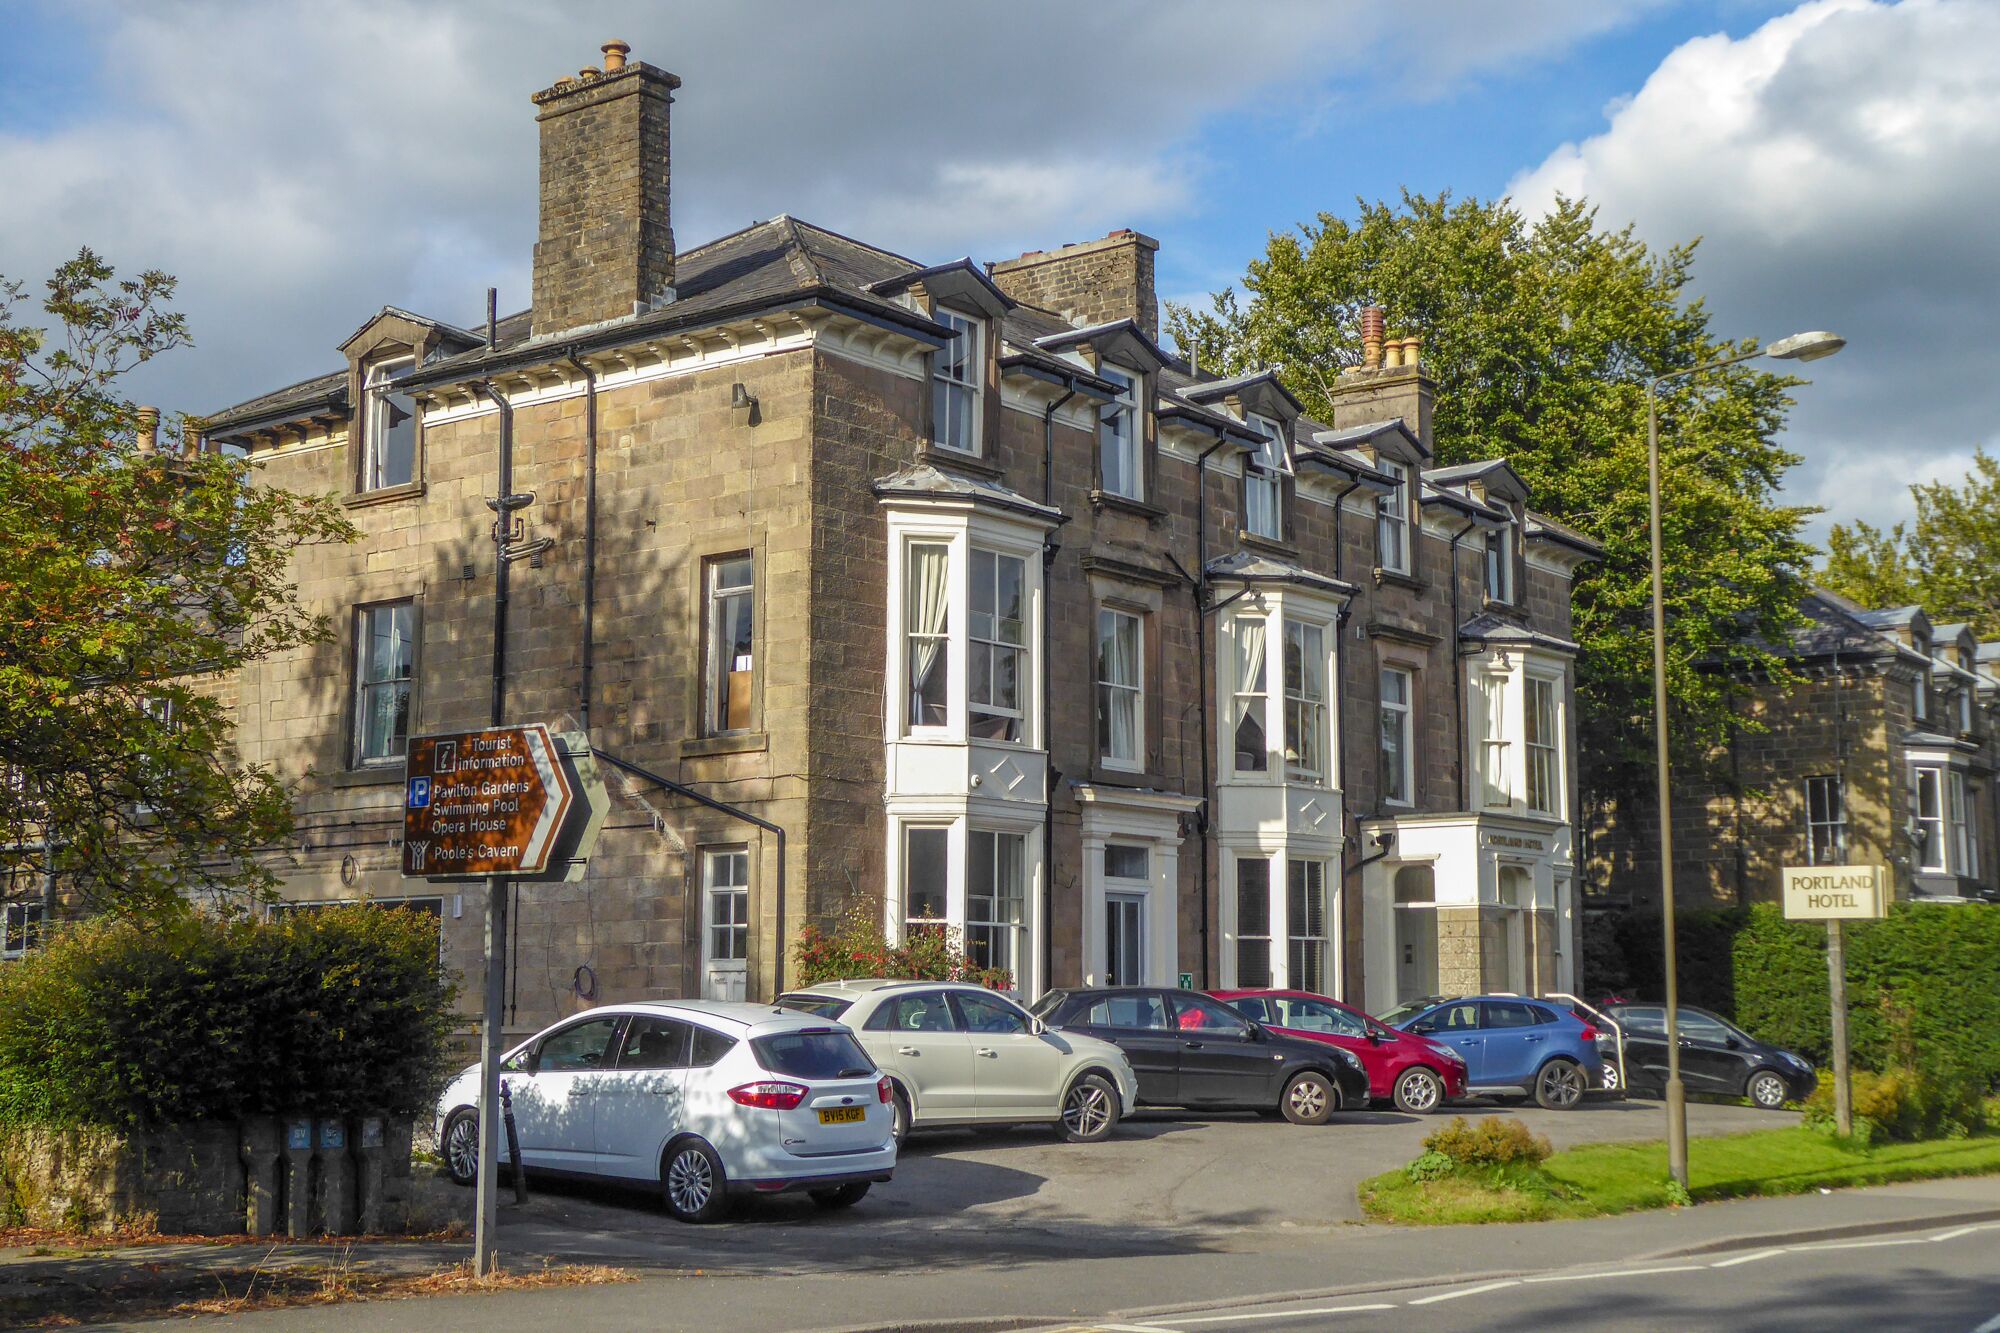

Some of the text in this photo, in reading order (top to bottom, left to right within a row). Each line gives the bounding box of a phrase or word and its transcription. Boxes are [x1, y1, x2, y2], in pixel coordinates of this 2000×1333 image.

[473, 735, 512, 752] Tourist
[458, 753, 524, 771] information
[414, 779, 428, 805] P
[433, 780, 529, 799] Pavilion Gardens
[432, 798, 519, 817] Swimming Pool
[432, 817, 507, 836] Opera House
[434, 843, 519, 860] Poole's Cavern
[1791, 875, 1874, 891] PORTLAND
[1808, 893, 1859, 909] HOTEL
[823, 1109, 844, 1122] BV15
